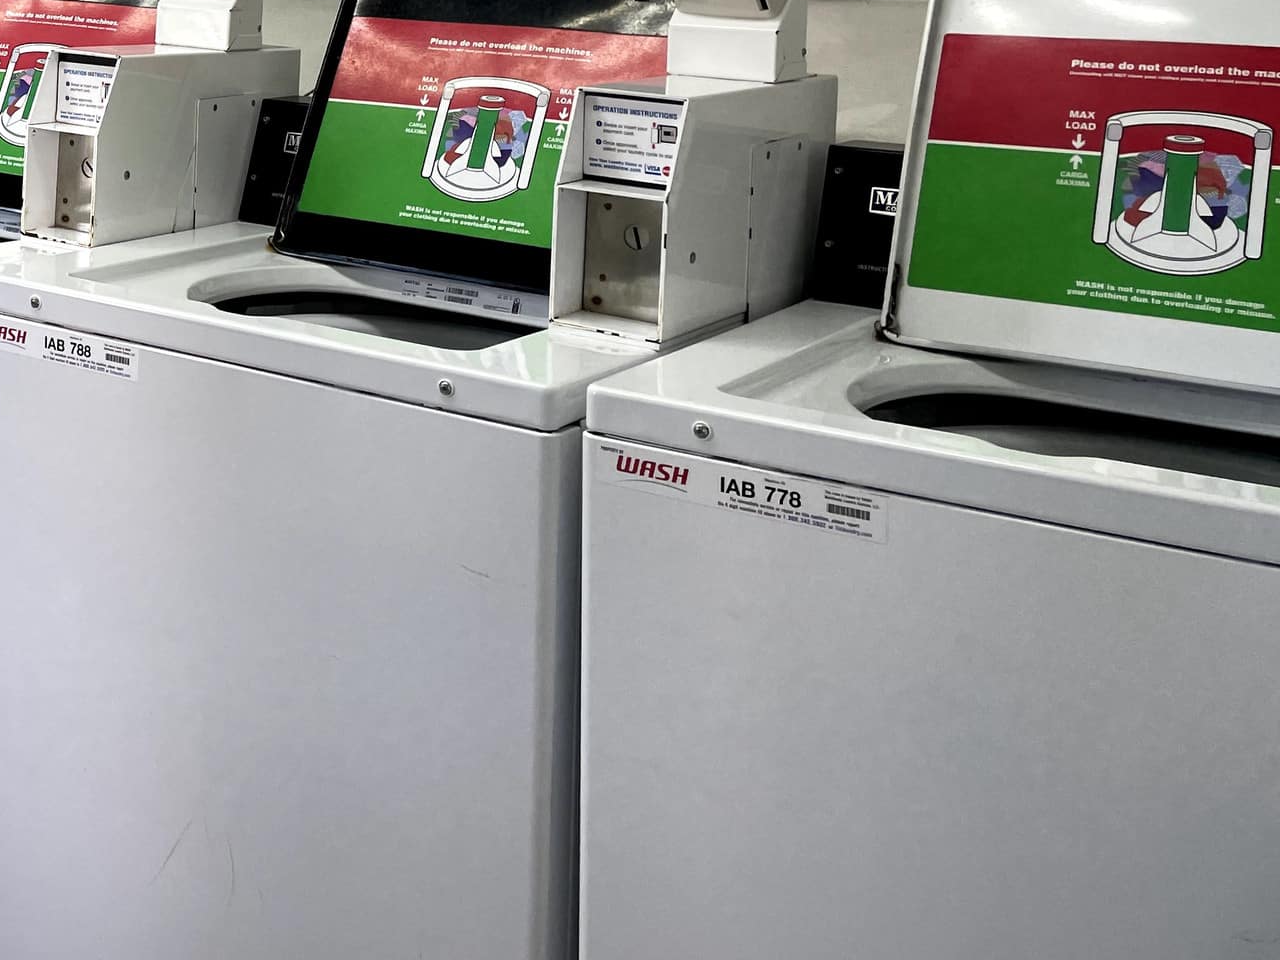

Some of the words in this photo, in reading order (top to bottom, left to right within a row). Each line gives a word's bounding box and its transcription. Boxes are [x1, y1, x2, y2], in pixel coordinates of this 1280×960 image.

[430, 38, 458, 46] Please
[460, 39, 470, 47] do
[489, 41, 527, 51] overload
[546, 47, 594, 57] machines.
[1071, 59, 1114, 69] Please
[1118, 61, 1134, 70] do
[1164, 65, 1223, 75] overload
[1228, 67, 1250, 76] the
[593, 105, 628, 114] OPERATION
[630, 108, 677, 119] INSTRUCTIONS
[1069, 110, 1095, 119] MAX
[1066, 121, 1096, 130] LOAD
[45, 336, 65, 352] IAB
[70, 342, 91, 358] 788
[617, 455, 688, 484] WASH
[720, 476, 755, 499] IAB
[764, 486, 802, 508] 778
